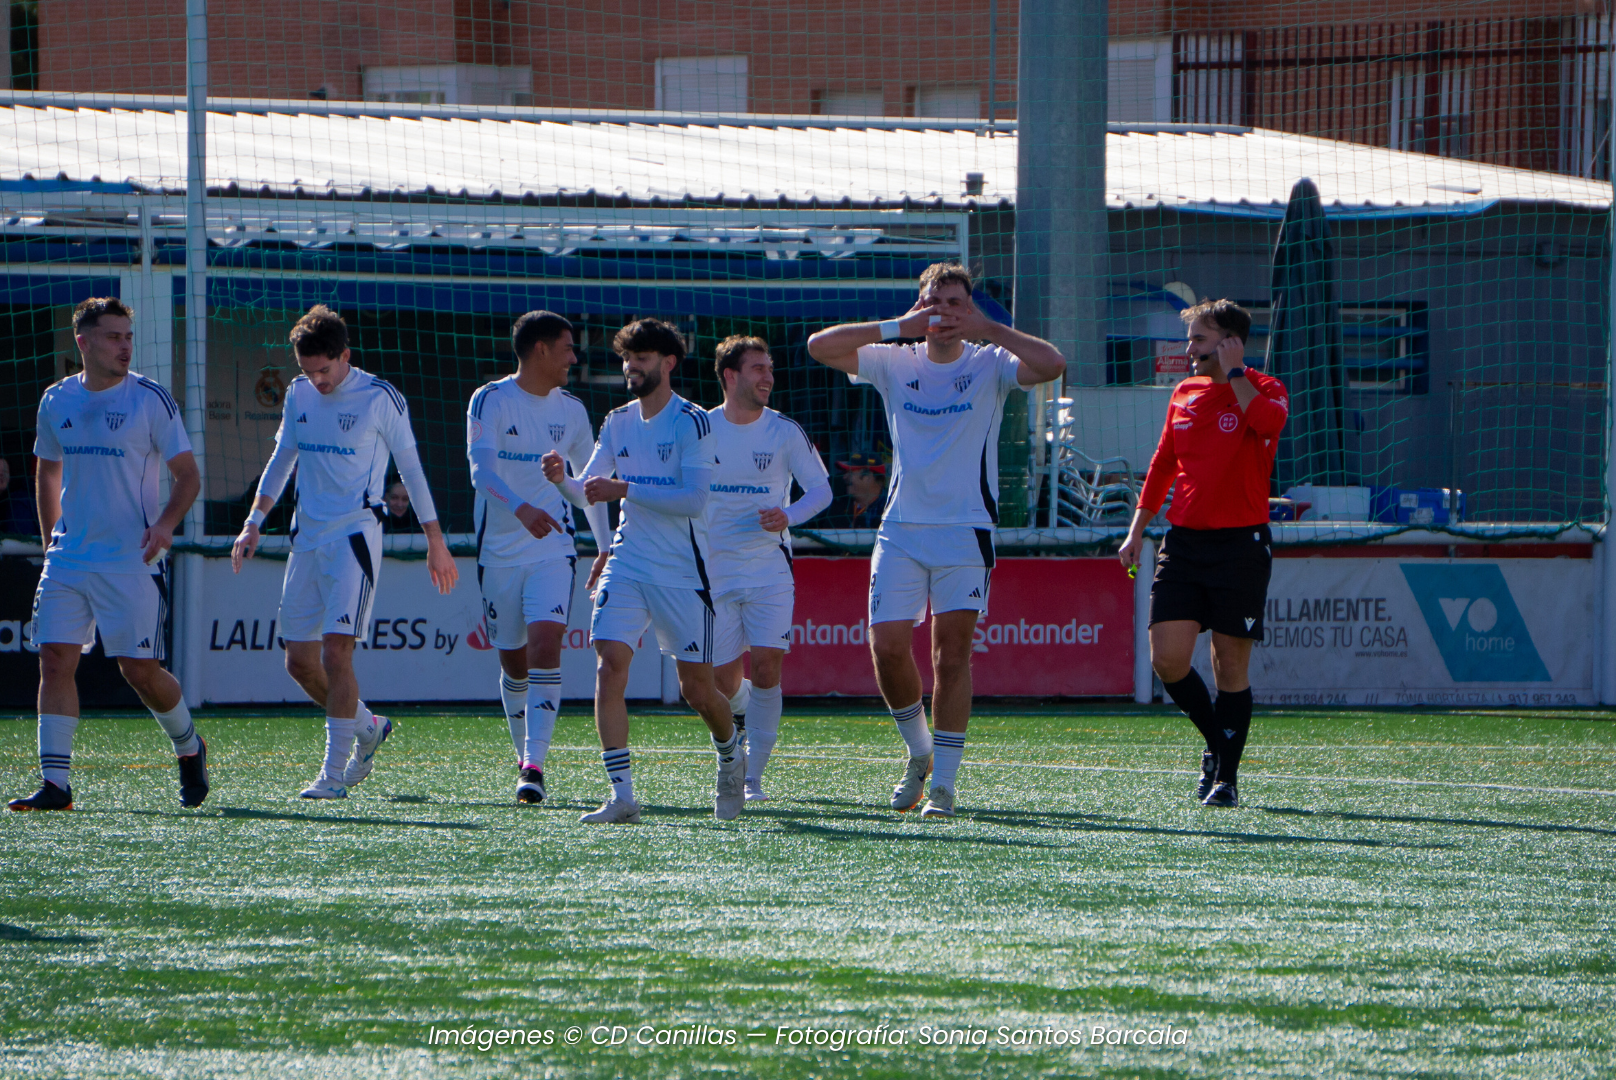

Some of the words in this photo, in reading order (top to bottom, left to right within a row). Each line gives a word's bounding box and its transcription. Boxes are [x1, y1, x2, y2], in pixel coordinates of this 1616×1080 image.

[1157, 355, 1188, 365] Alarma
[903, 401, 973, 416] QUAMTRAX
[297, 441, 356, 456] QUAMTRAX
[497, 450, 542, 463] QUAMT
[622, 474, 676, 486] UAMTRAX
[1267, 597, 1393, 623] ILLAMENTE.
[209, 618, 286, 651] LALI
[356, 617, 428, 651] ESS
[434, 628, 460, 656] by
[790, 618, 870, 646] ntand
[972, 618, 1104, 646] Santander
[1253, 626, 1325, 649] DEMOS
[1330, 626, 1353, 648] TU
[1360, 626, 1409, 648] CASA
[1465, 632, 1515, 651] home
